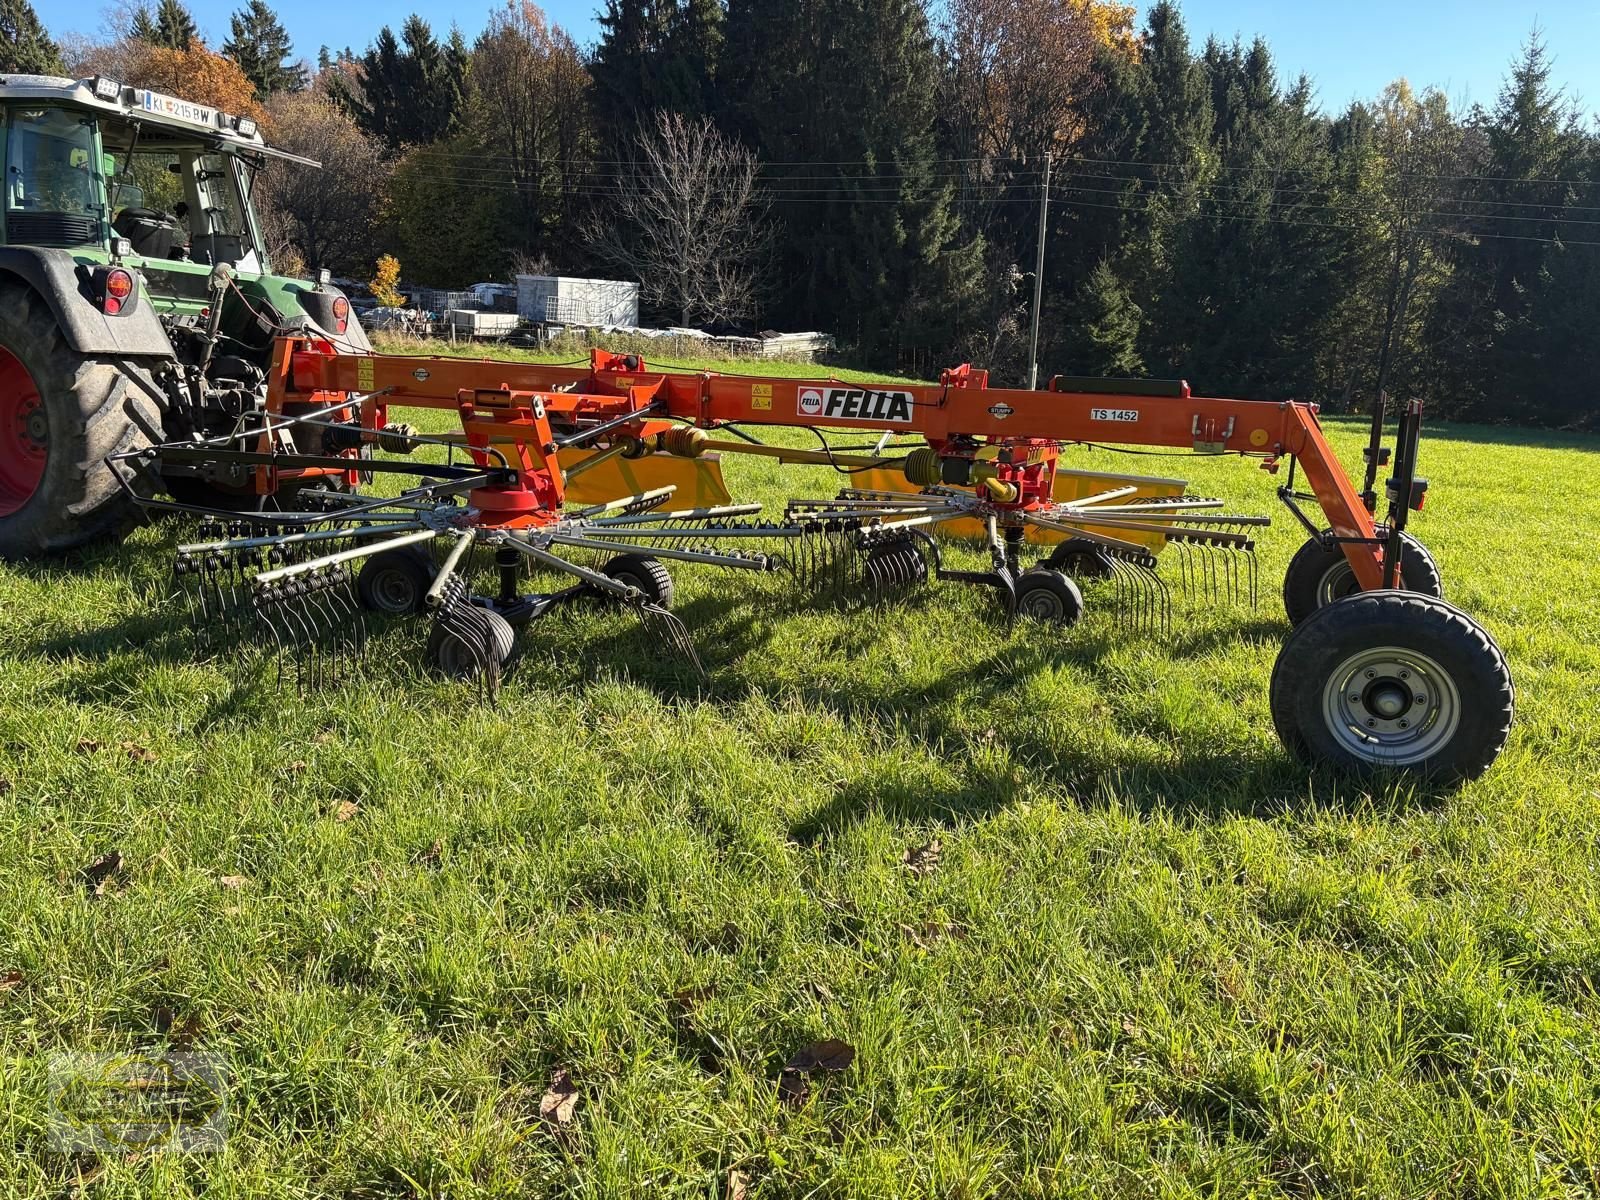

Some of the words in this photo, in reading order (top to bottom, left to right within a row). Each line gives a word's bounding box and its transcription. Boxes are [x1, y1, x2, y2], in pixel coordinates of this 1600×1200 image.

[153, 97, 165, 112] KL
[174, 103, 191, 118] 215
[193, 108, 209, 123] BW
[801, 398, 820, 406] FELLA
[824, 390, 910, 420] FELLA
[1093, 410, 1107, 419] TS
[1112, 411, 1137, 420] 1452
